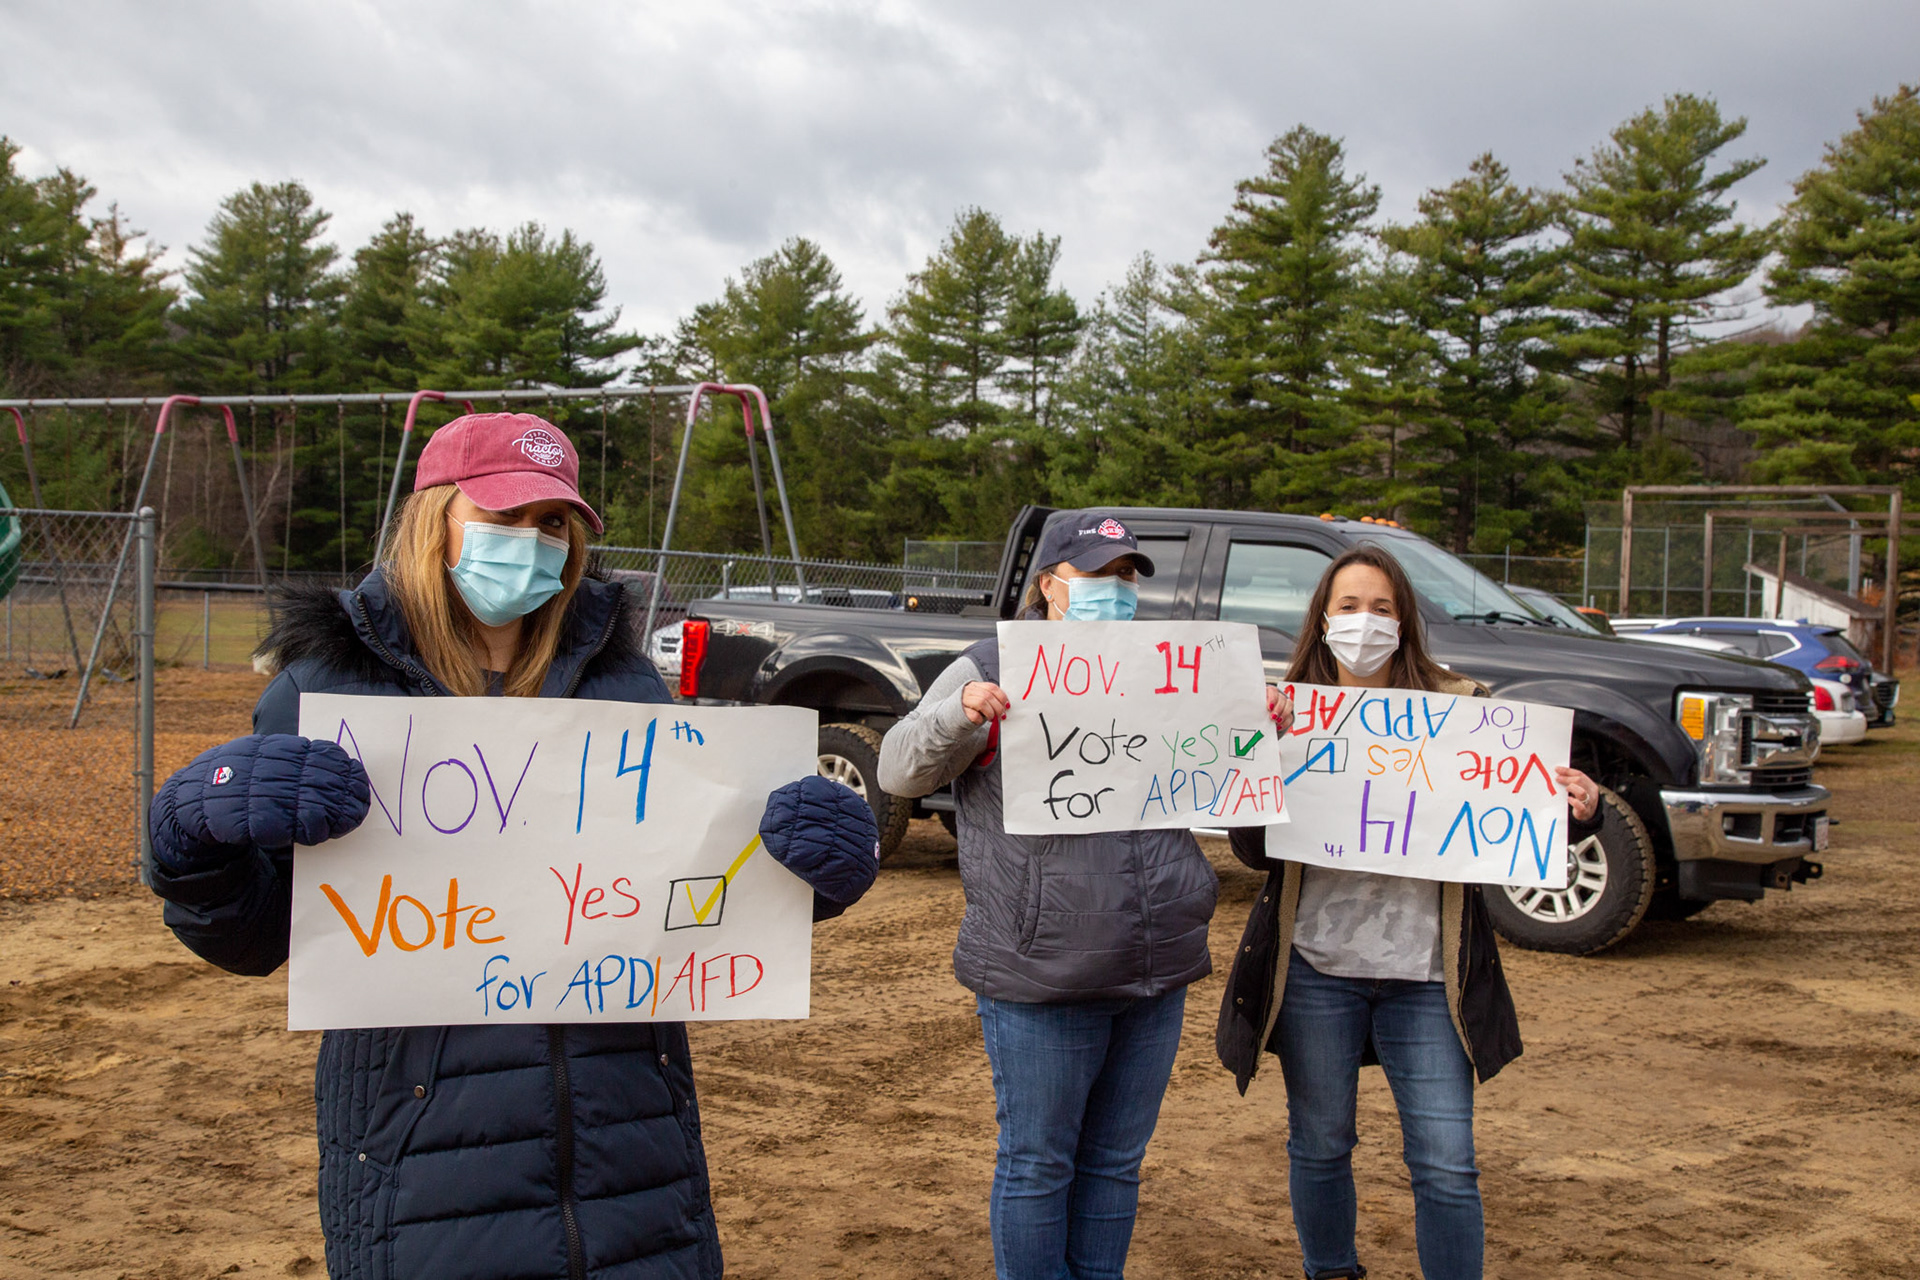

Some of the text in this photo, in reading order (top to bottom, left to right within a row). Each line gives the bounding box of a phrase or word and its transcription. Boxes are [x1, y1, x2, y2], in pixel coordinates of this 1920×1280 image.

[1039, 712, 1148, 765] Vote
[1470, 705, 1530, 750] for
[1043, 769, 1115, 820] for
[1456, 750, 1557, 796] Vote
[319, 874, 506, 958] Vote
[476, 955, 548, 1017] for
